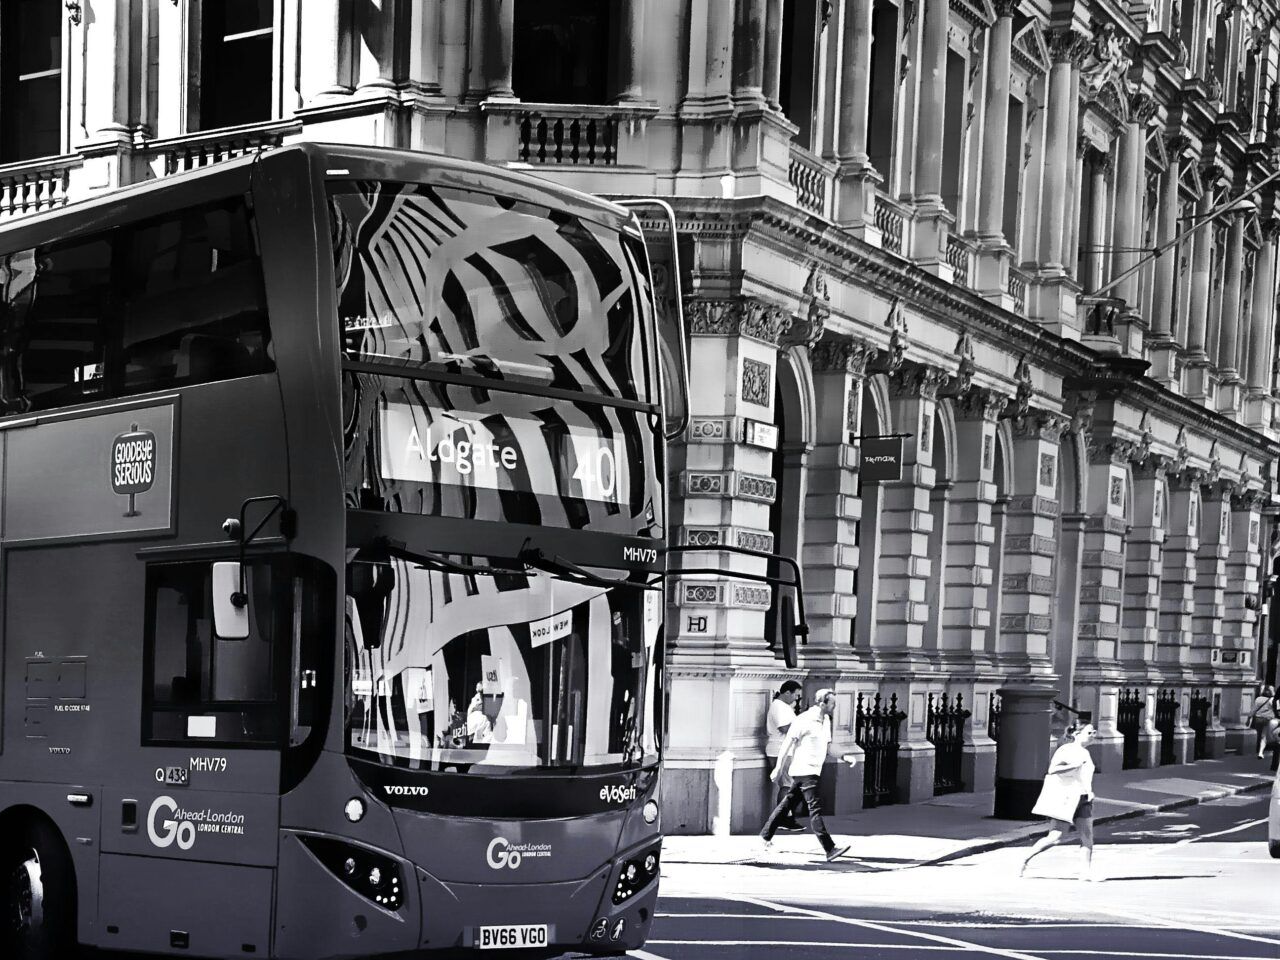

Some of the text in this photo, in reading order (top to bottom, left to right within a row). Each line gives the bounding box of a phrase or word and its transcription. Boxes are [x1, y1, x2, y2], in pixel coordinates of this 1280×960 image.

[405, 427, 517, 474] Aldgate
[572, 447, 615, 498] 40
[623, 546, 657, 563] MHV79
[189, 757, 227, 772] MHV79
[155, 767, 165, 782] Q
[384, 785, 429, 796] VOLVO
[197, 823, 245, 834] LONDON CENTRAL
[482, 927, 546, 946] BV66 VGO
